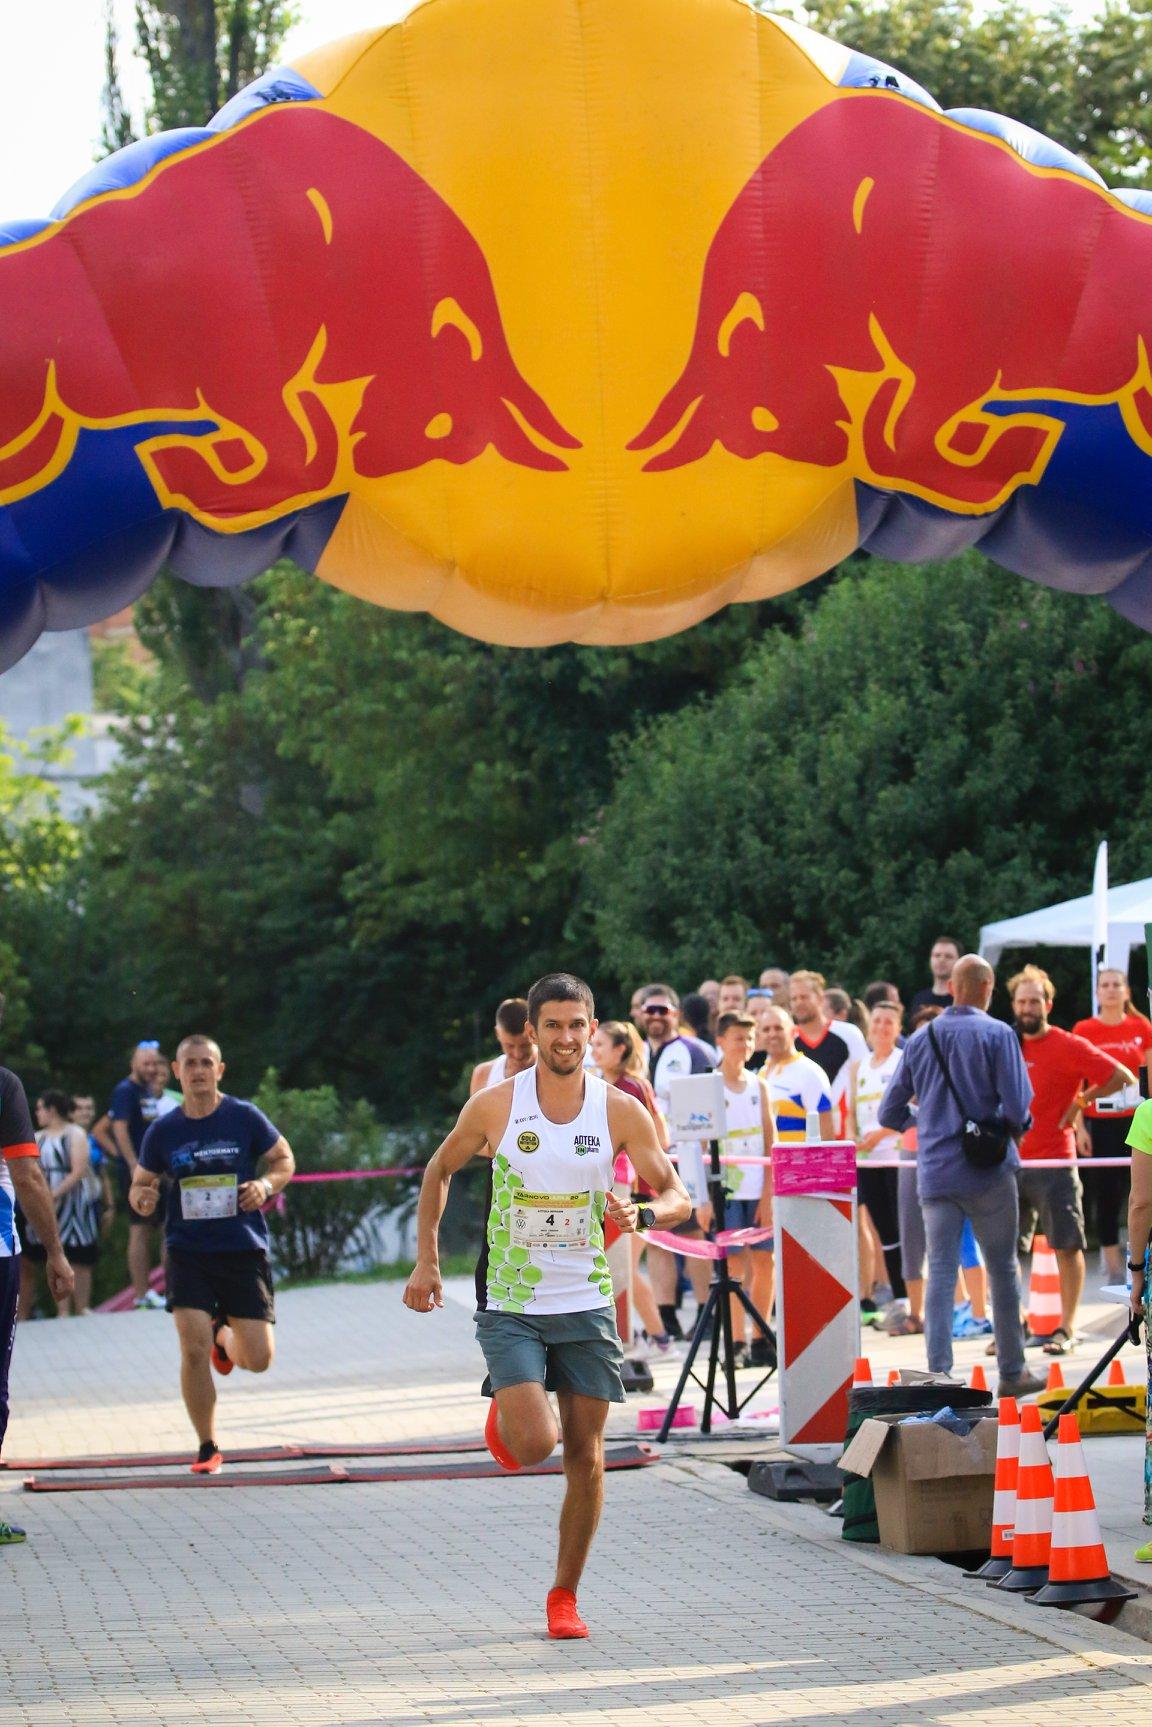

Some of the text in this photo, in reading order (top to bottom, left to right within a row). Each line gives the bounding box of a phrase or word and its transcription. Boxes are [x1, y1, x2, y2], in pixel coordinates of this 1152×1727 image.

[516, 1192, 550, 1200] TARNOVO
[545, 1214, 570, 1226] 4 2
